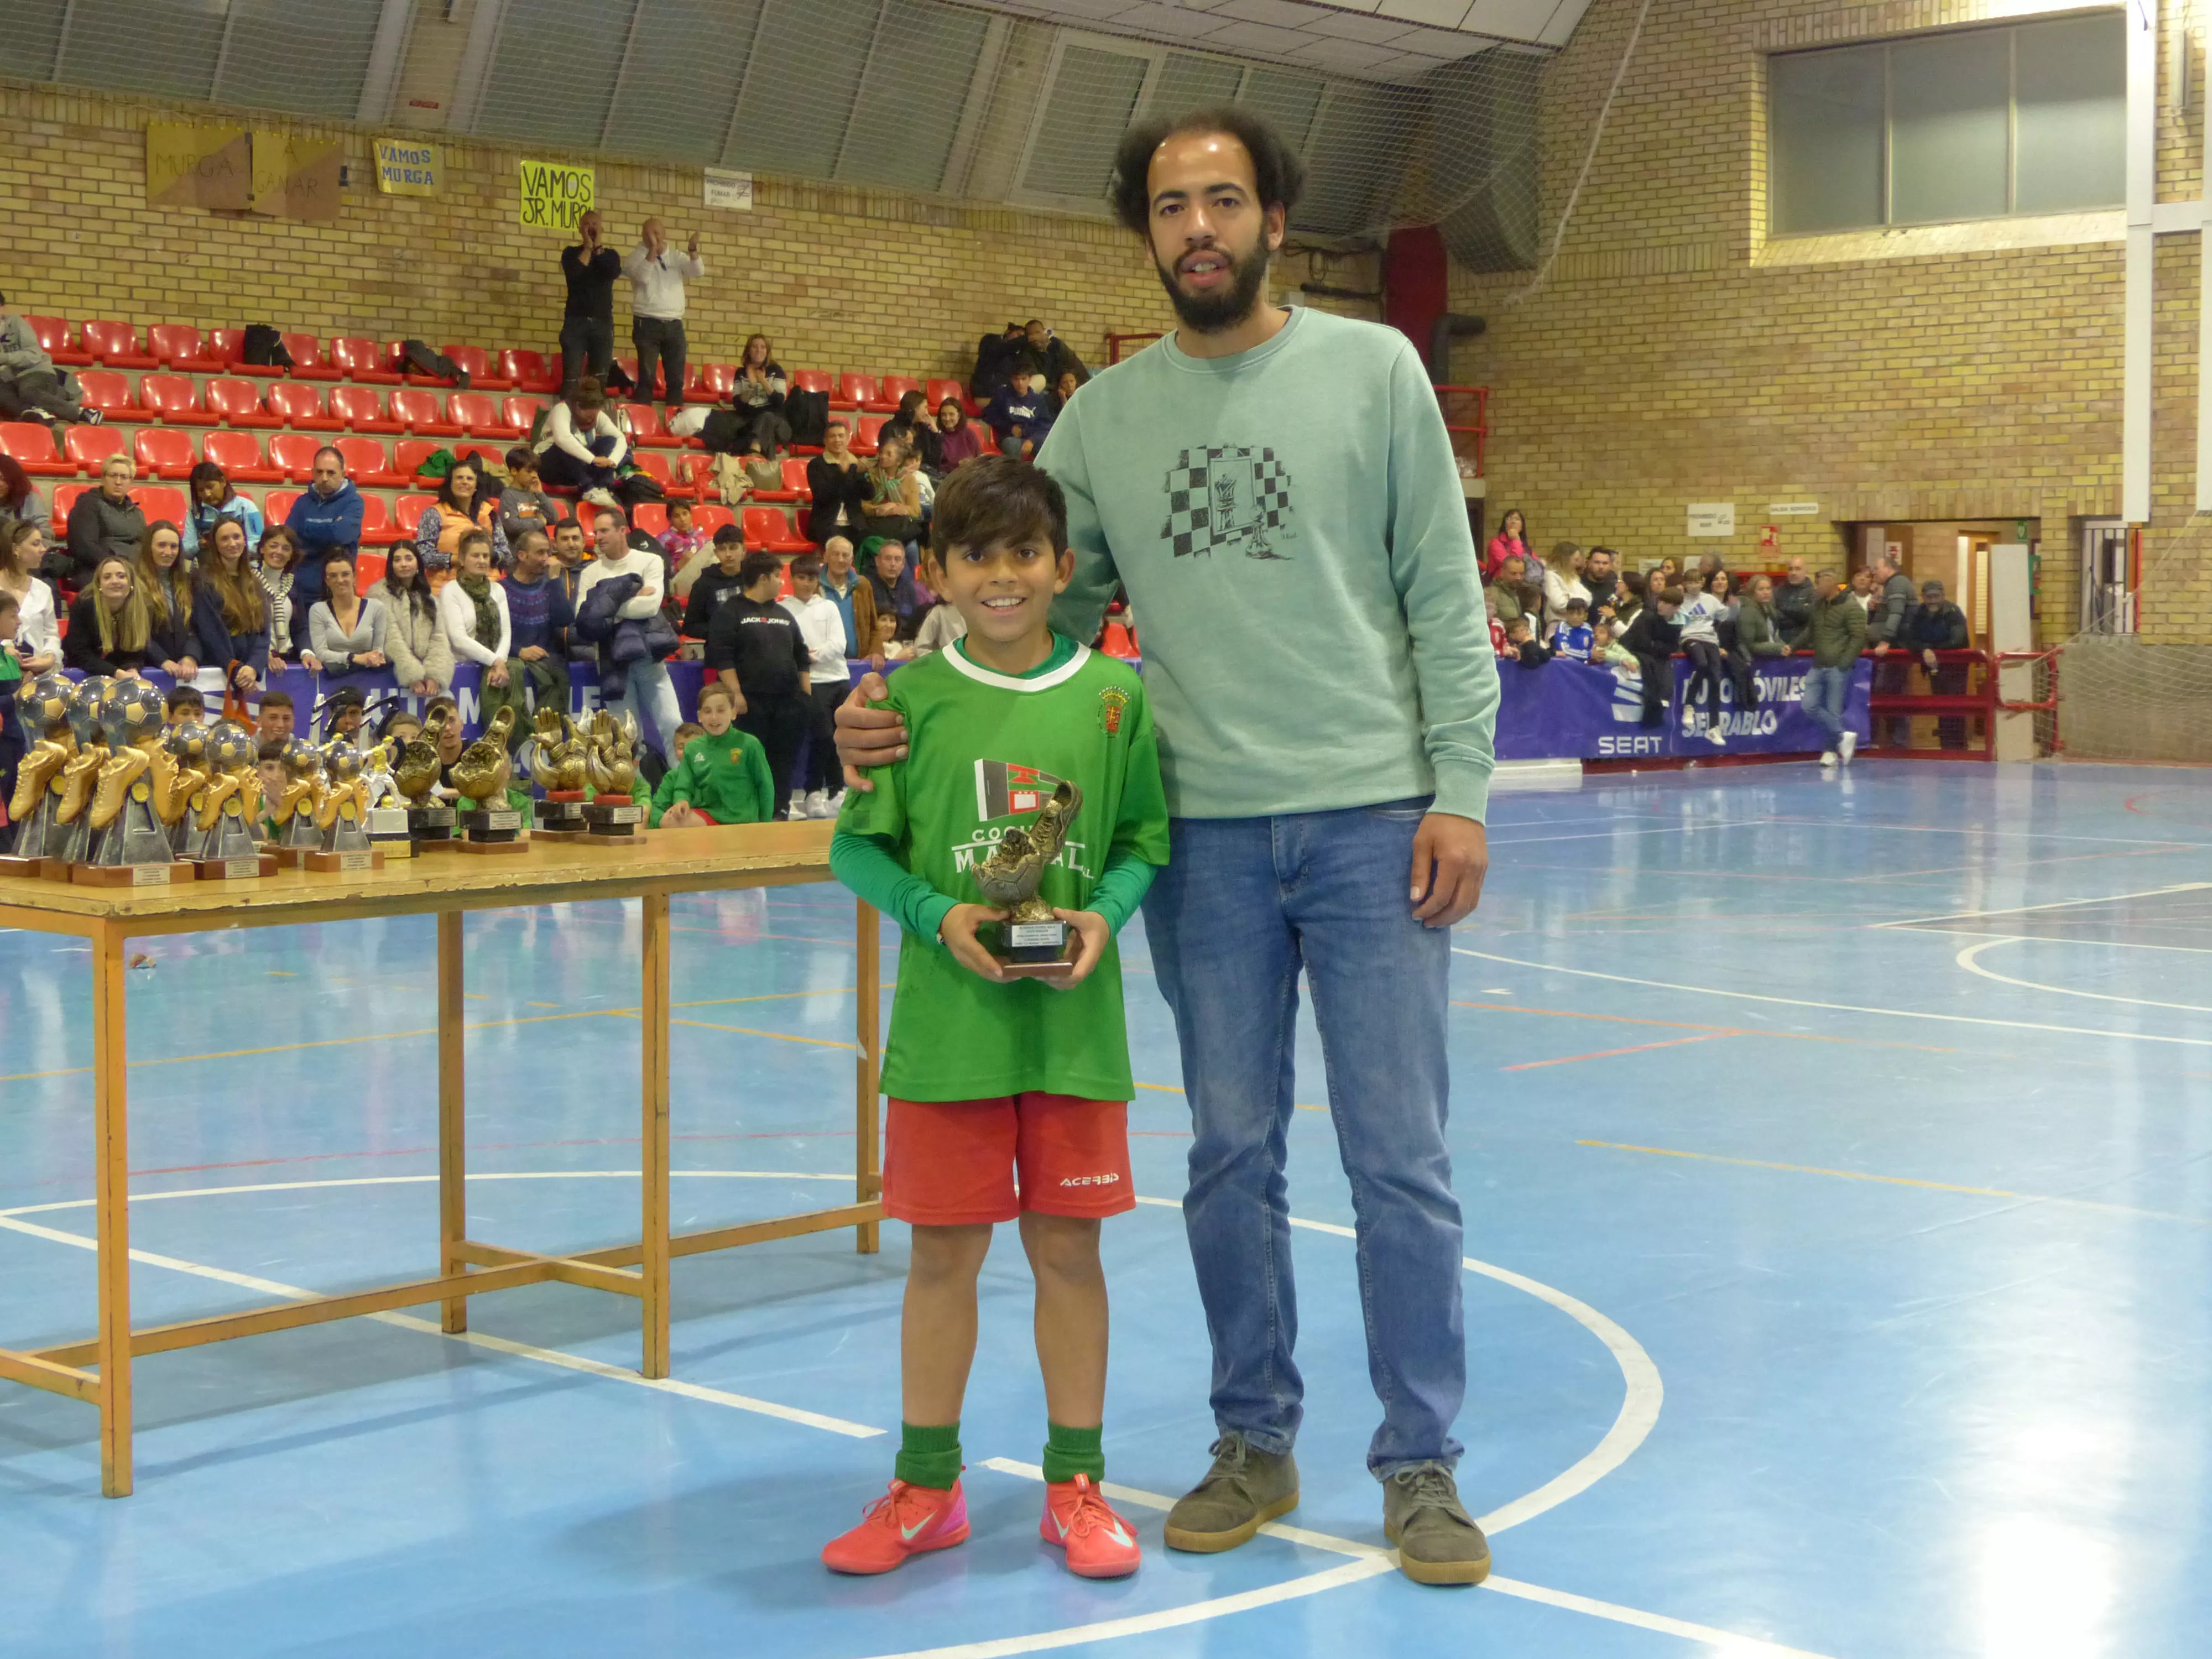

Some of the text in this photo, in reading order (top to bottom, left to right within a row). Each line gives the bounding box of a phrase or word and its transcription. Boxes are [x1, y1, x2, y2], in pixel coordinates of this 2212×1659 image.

[155, 153, 234, 178] MURGA
[379, 145, 431, 165] VAMOS
[254, 170, 318, 198] GANAR
[382, 165, 435, 186] MURGA
[522, 165, 592, 202] VAMOS
[523, 197, 549, 226] JR.
[1598, 736, 1662, 754] SEAT
